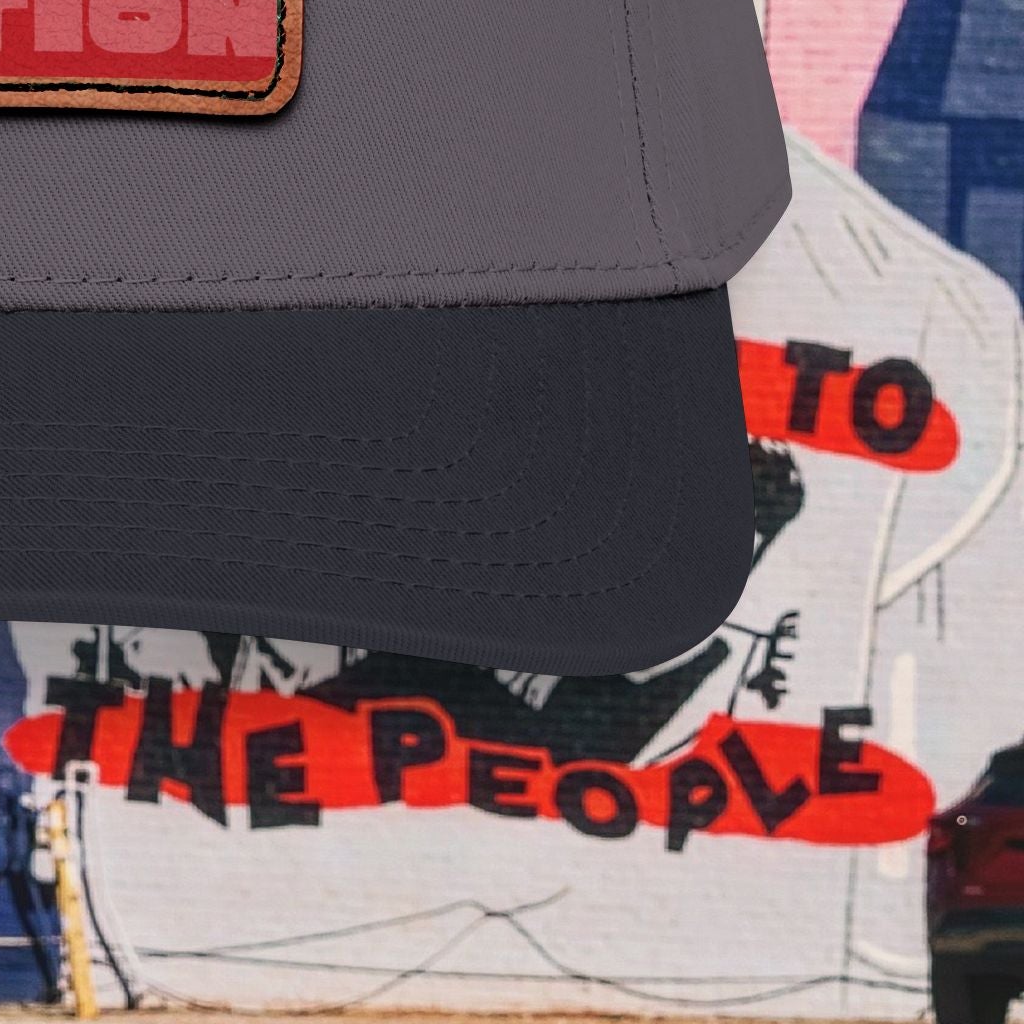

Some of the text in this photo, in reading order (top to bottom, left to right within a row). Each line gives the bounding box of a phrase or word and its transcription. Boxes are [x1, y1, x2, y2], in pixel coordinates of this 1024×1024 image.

[785, 339, 933, 454] TO
[45, 675, 882, 853] THE PEOPLE
